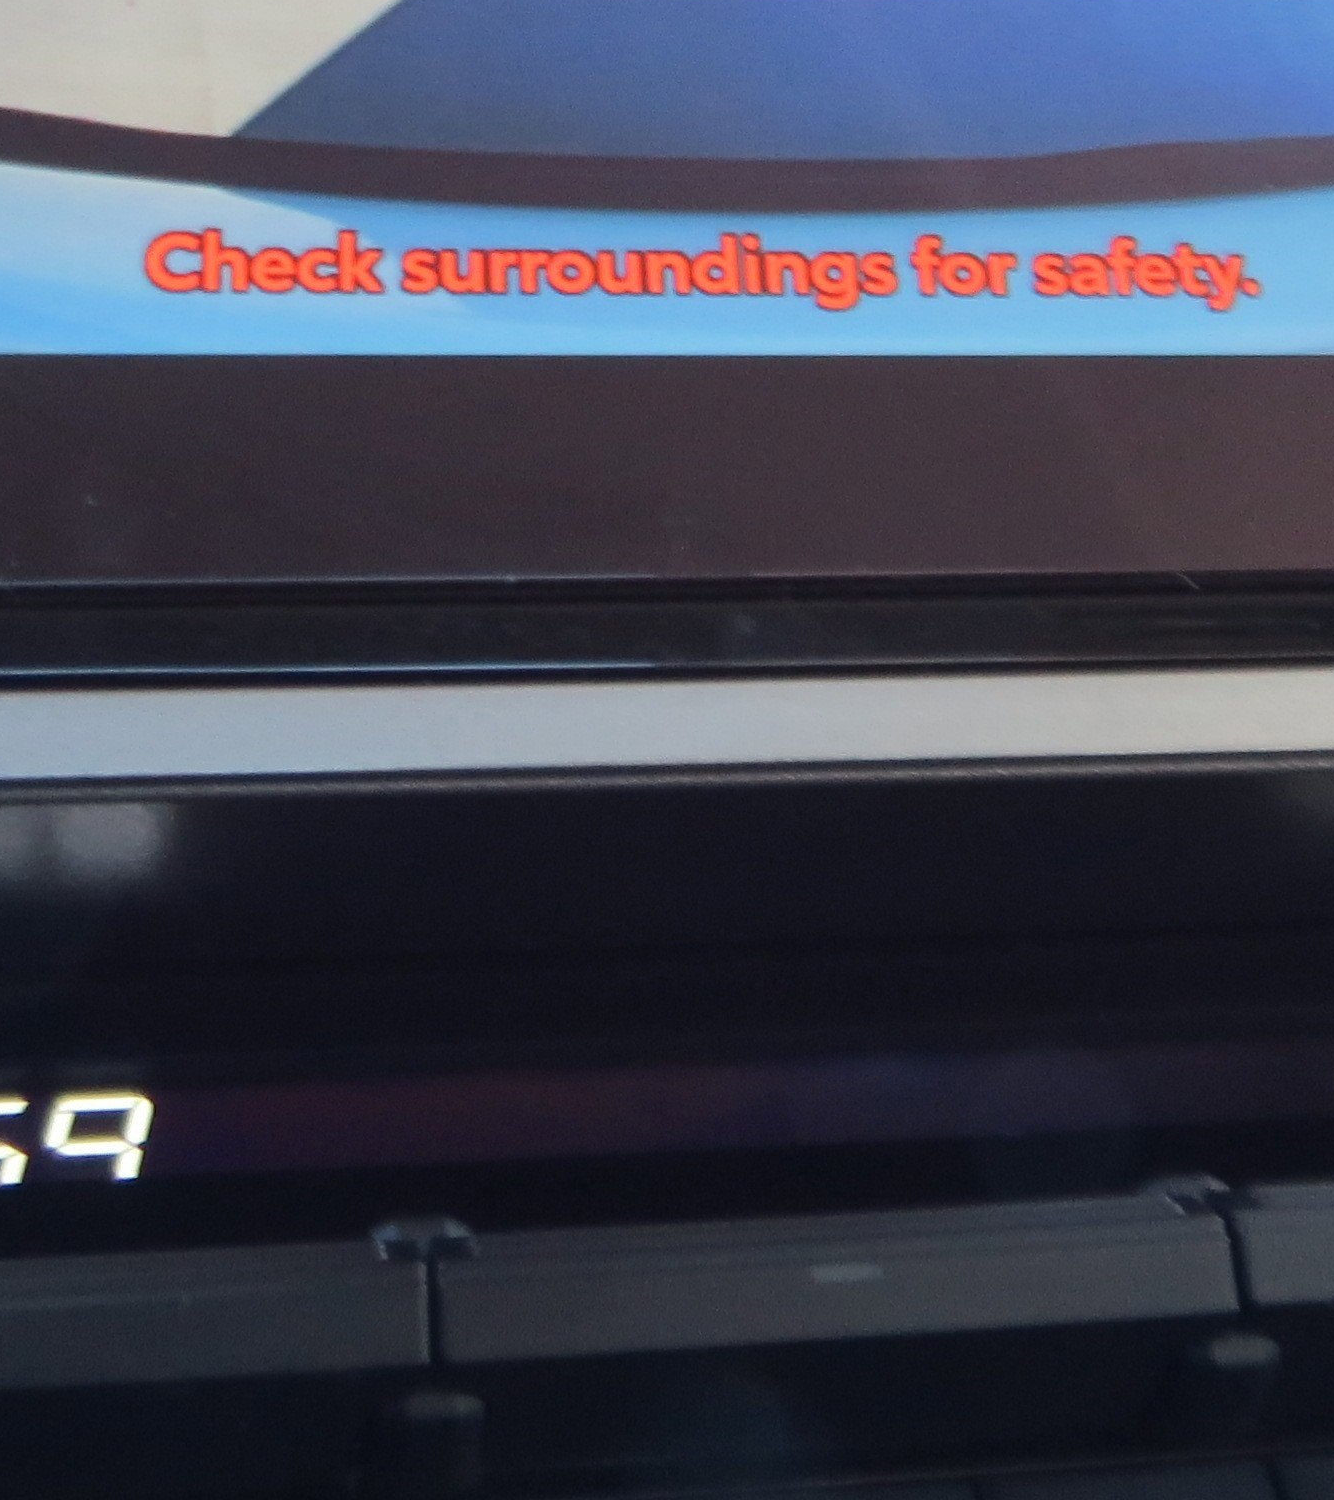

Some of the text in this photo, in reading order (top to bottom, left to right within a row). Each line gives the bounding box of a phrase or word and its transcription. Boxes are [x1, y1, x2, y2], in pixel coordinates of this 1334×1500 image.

[144, 227, 1262, 312] Check surroundings for safety.
